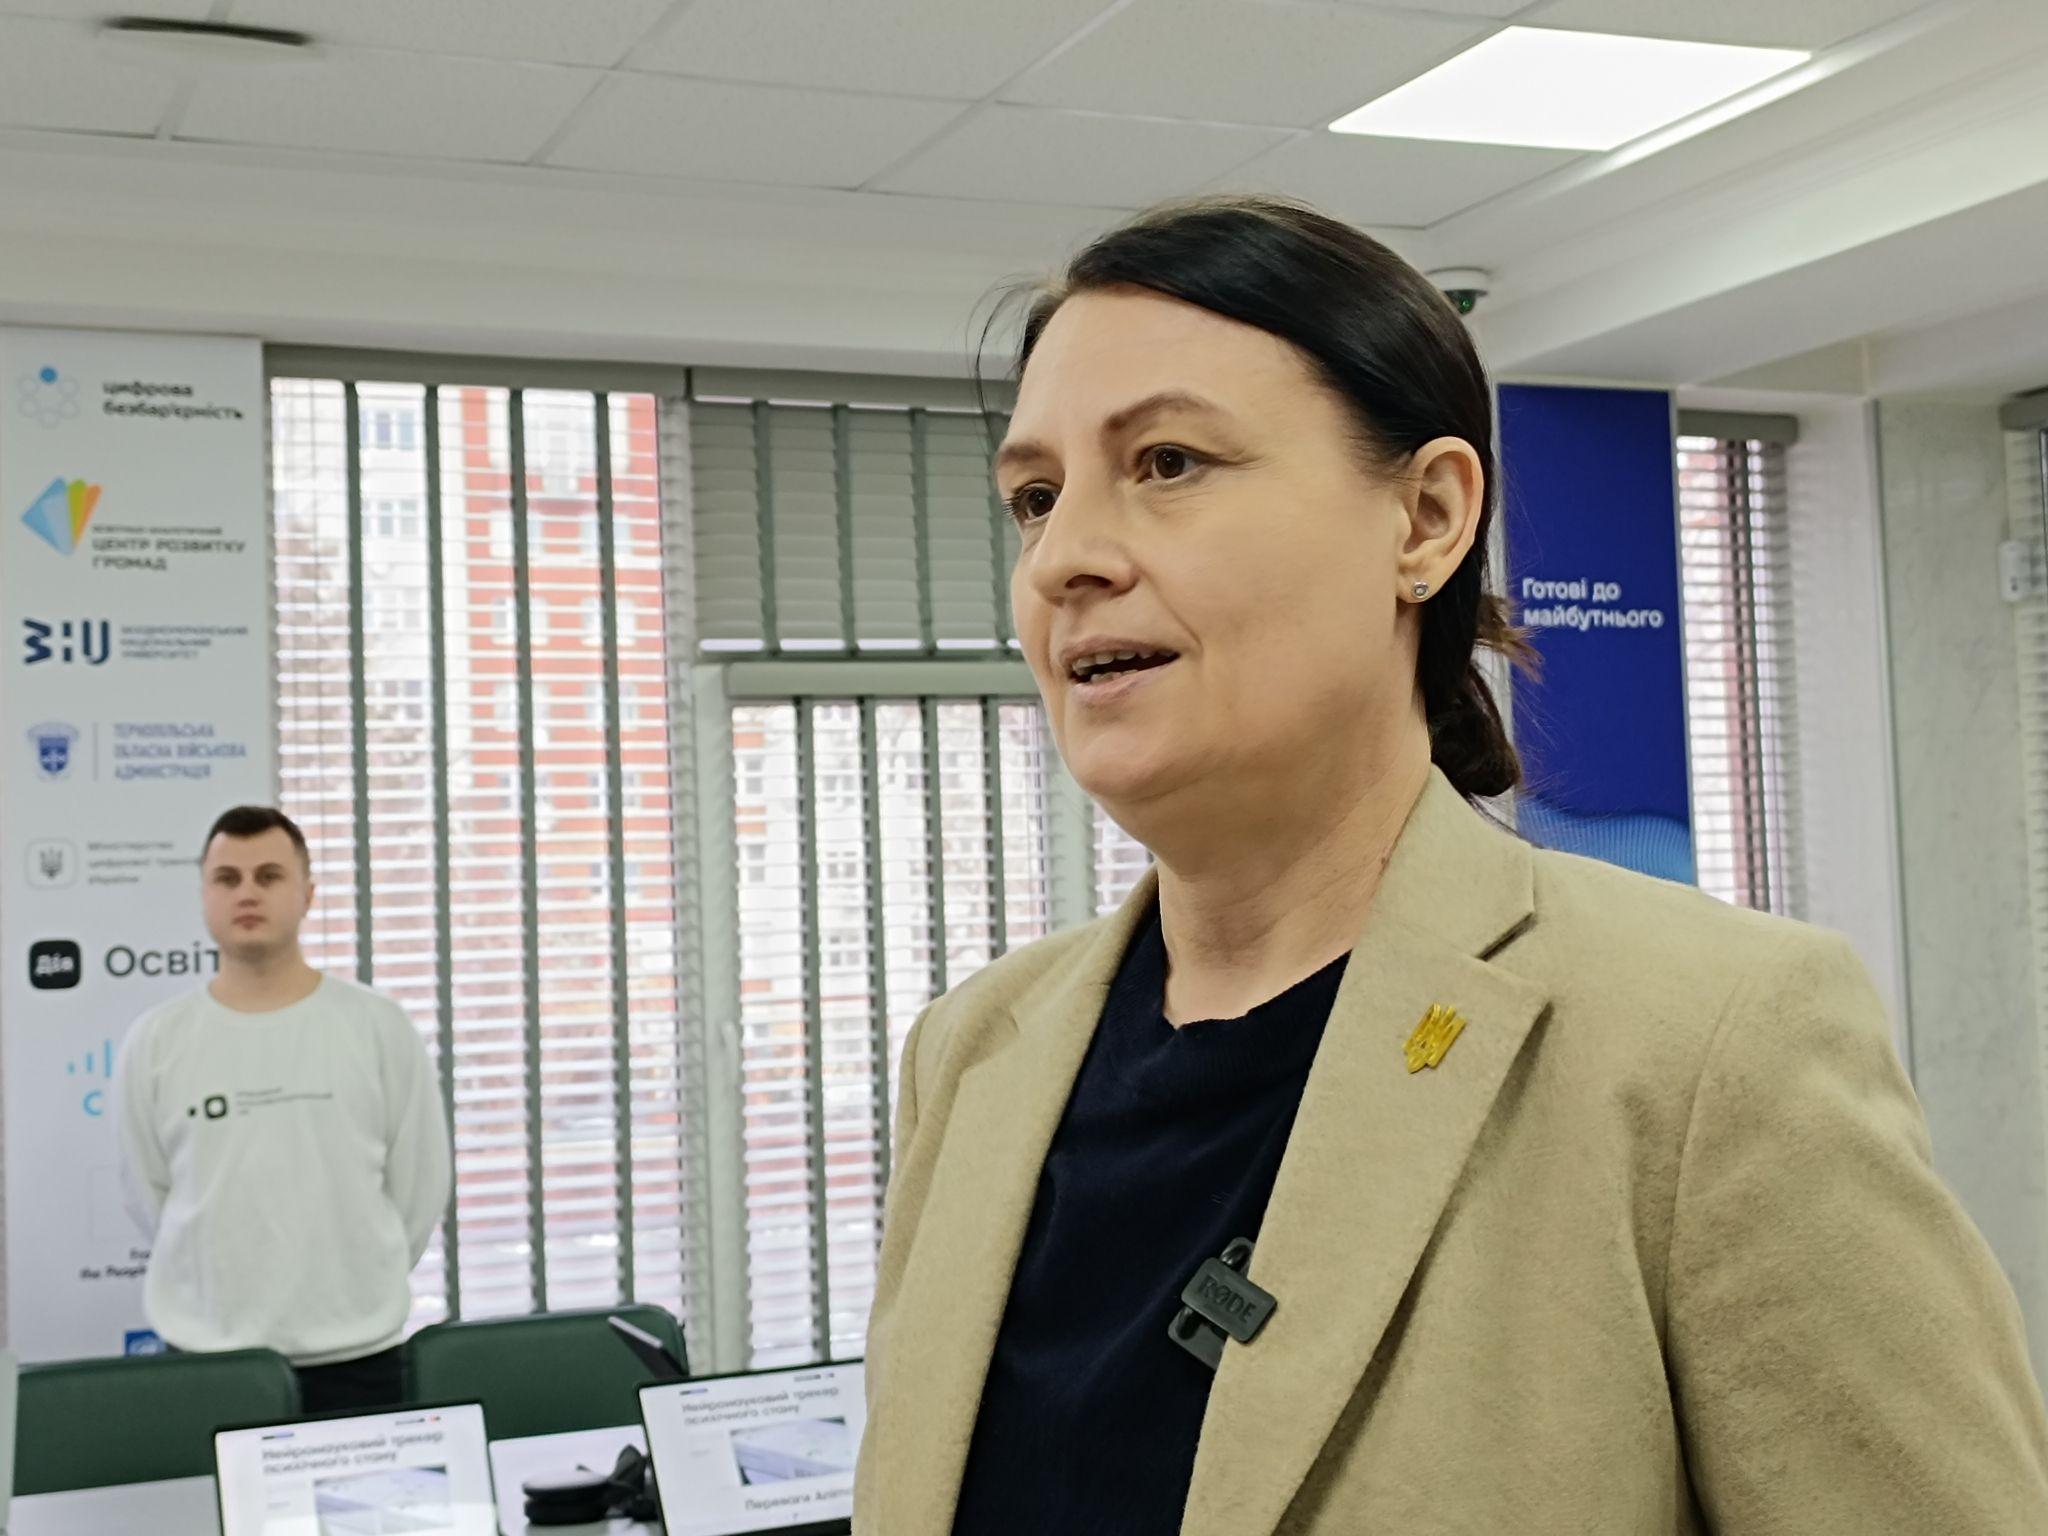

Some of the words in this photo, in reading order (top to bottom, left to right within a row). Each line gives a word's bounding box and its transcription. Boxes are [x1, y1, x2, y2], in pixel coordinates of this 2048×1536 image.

[103, 381, 193, 397] цифрова
[92, 538, 150, 552] ЦЕНТР
[156, 539, 245, 553] РОЗВИТКУ
[92, 556, 167, 571] ГРОМАД
[1522, 577, 1589, 600] Готові
[1592, 581, 1622, 602] до
[1523, 606, 1664, 631] майбутнього
[35, 952, 75, 977] Дія
